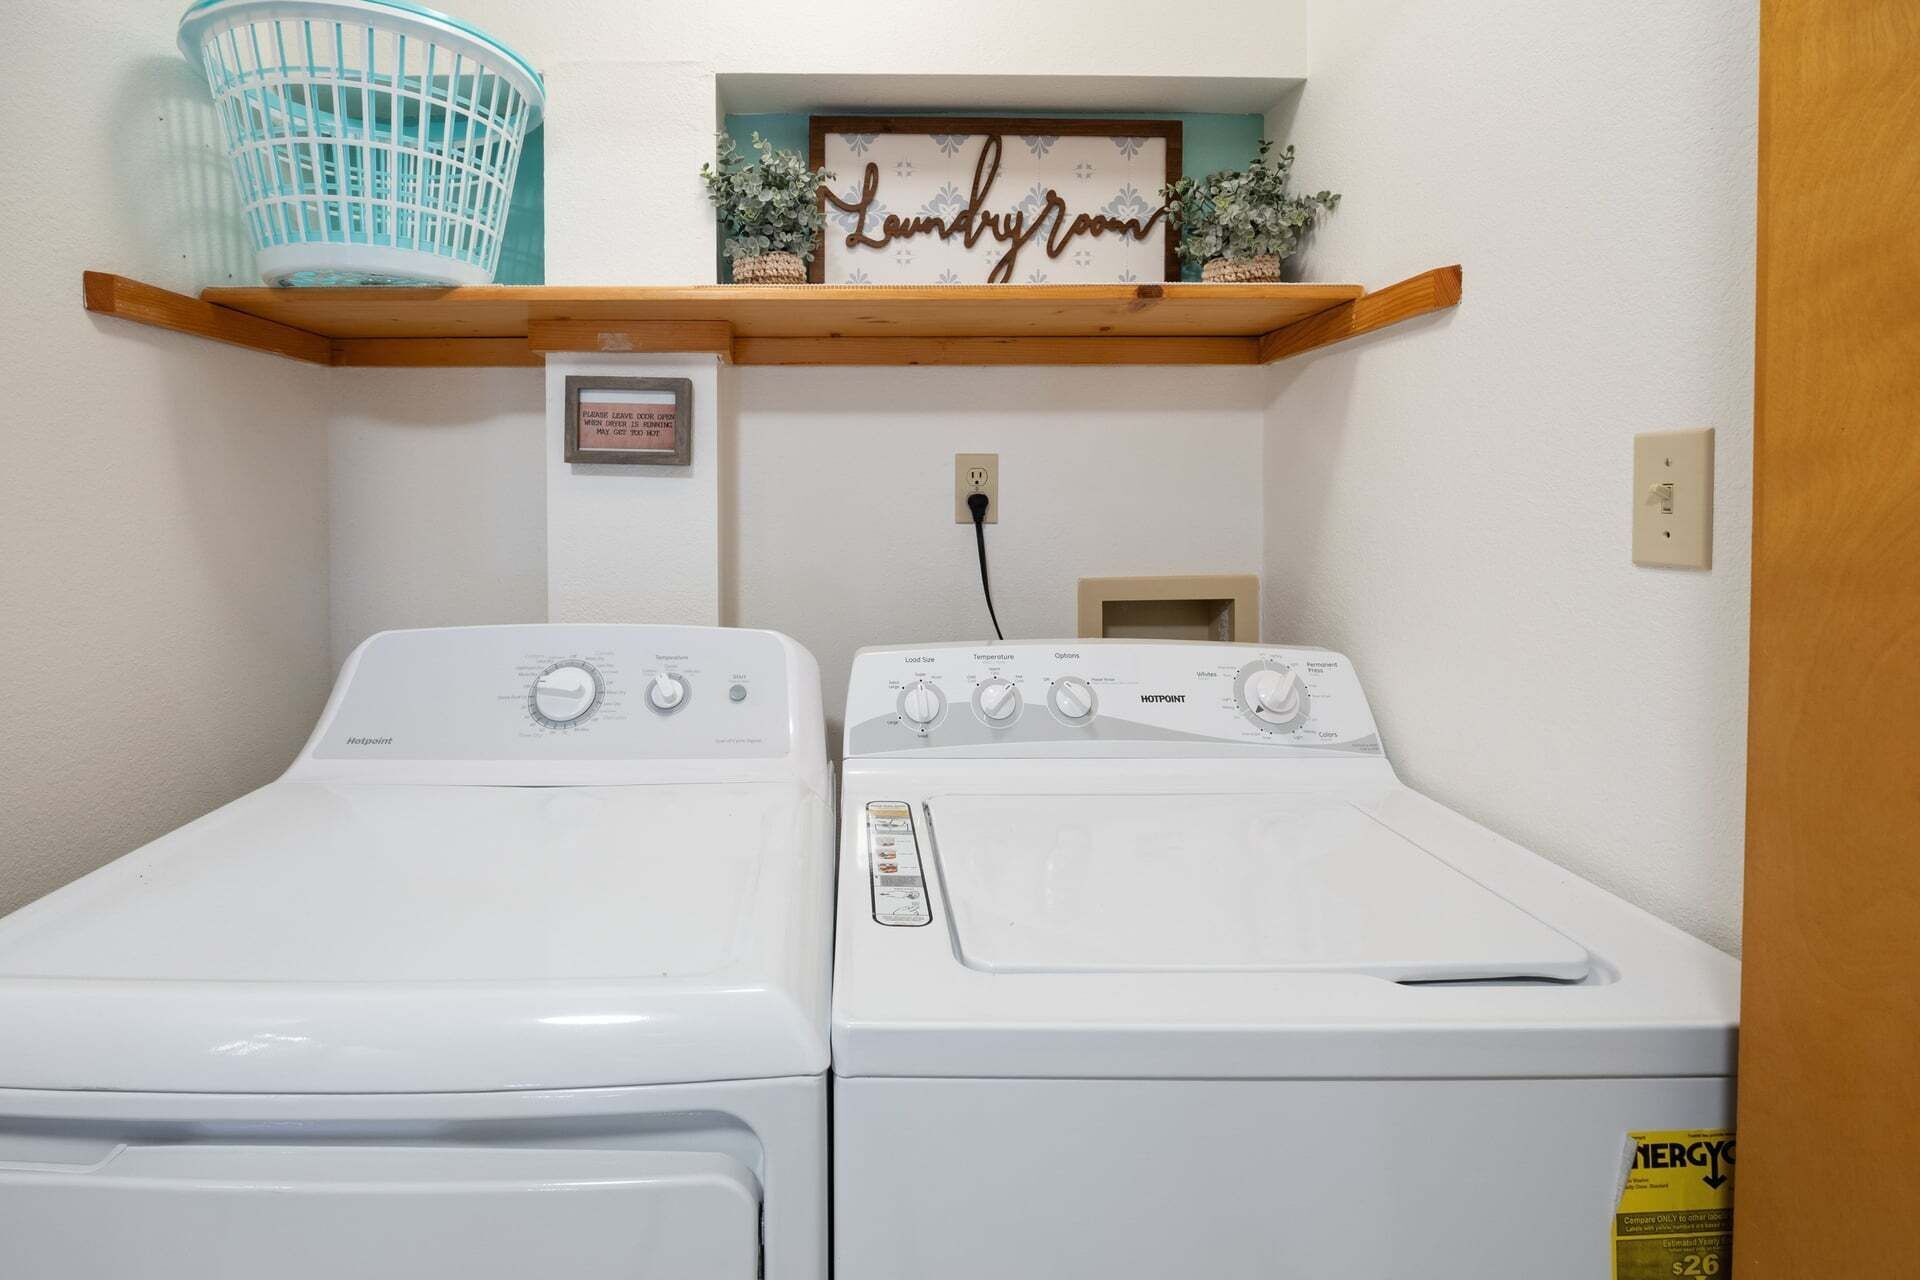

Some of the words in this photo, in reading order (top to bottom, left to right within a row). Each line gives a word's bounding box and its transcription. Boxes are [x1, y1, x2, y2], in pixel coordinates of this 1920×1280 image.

[816, 133, 1024, 284] Laundry
[1028, 189, 1168, 259] room
[582, 411, 609, 420] PLEASE
[611, 412, 634, 421] LEAVE
[636, 413, 656, 421] DOOR
[657, 413, 676, 421] OPEN
[583, 419, 603, 427] WHEN
[605, 420, 628, 428] DRYER
[631, 421, 642, 429] IS
[643, 421, 673, 429] RUNNING
[596, 428, 610, 436] MAY
[613, 429, 627, 437] GET
[629, 429, 644, 437] TOO
[646, 430, 661, 438] HOT
[973, 654, 1015, 662] Temperature
[1054, 652, 1080, 661] Options
[1140, 695, 1186, 703] HOTPOINT
[1318, 731, 1339, 739] Colors
[346, 736, 393, 746] Hotpoint
[1632, 1141, 1736, 1178] NERGY
[1623, 1216, 1656, 1226] Compare
[1657, 1214, 1678, 1224] ONLY
[1679, 1214, 1688, 1223] to
[1672, 1254, 1720, 1276] $26
